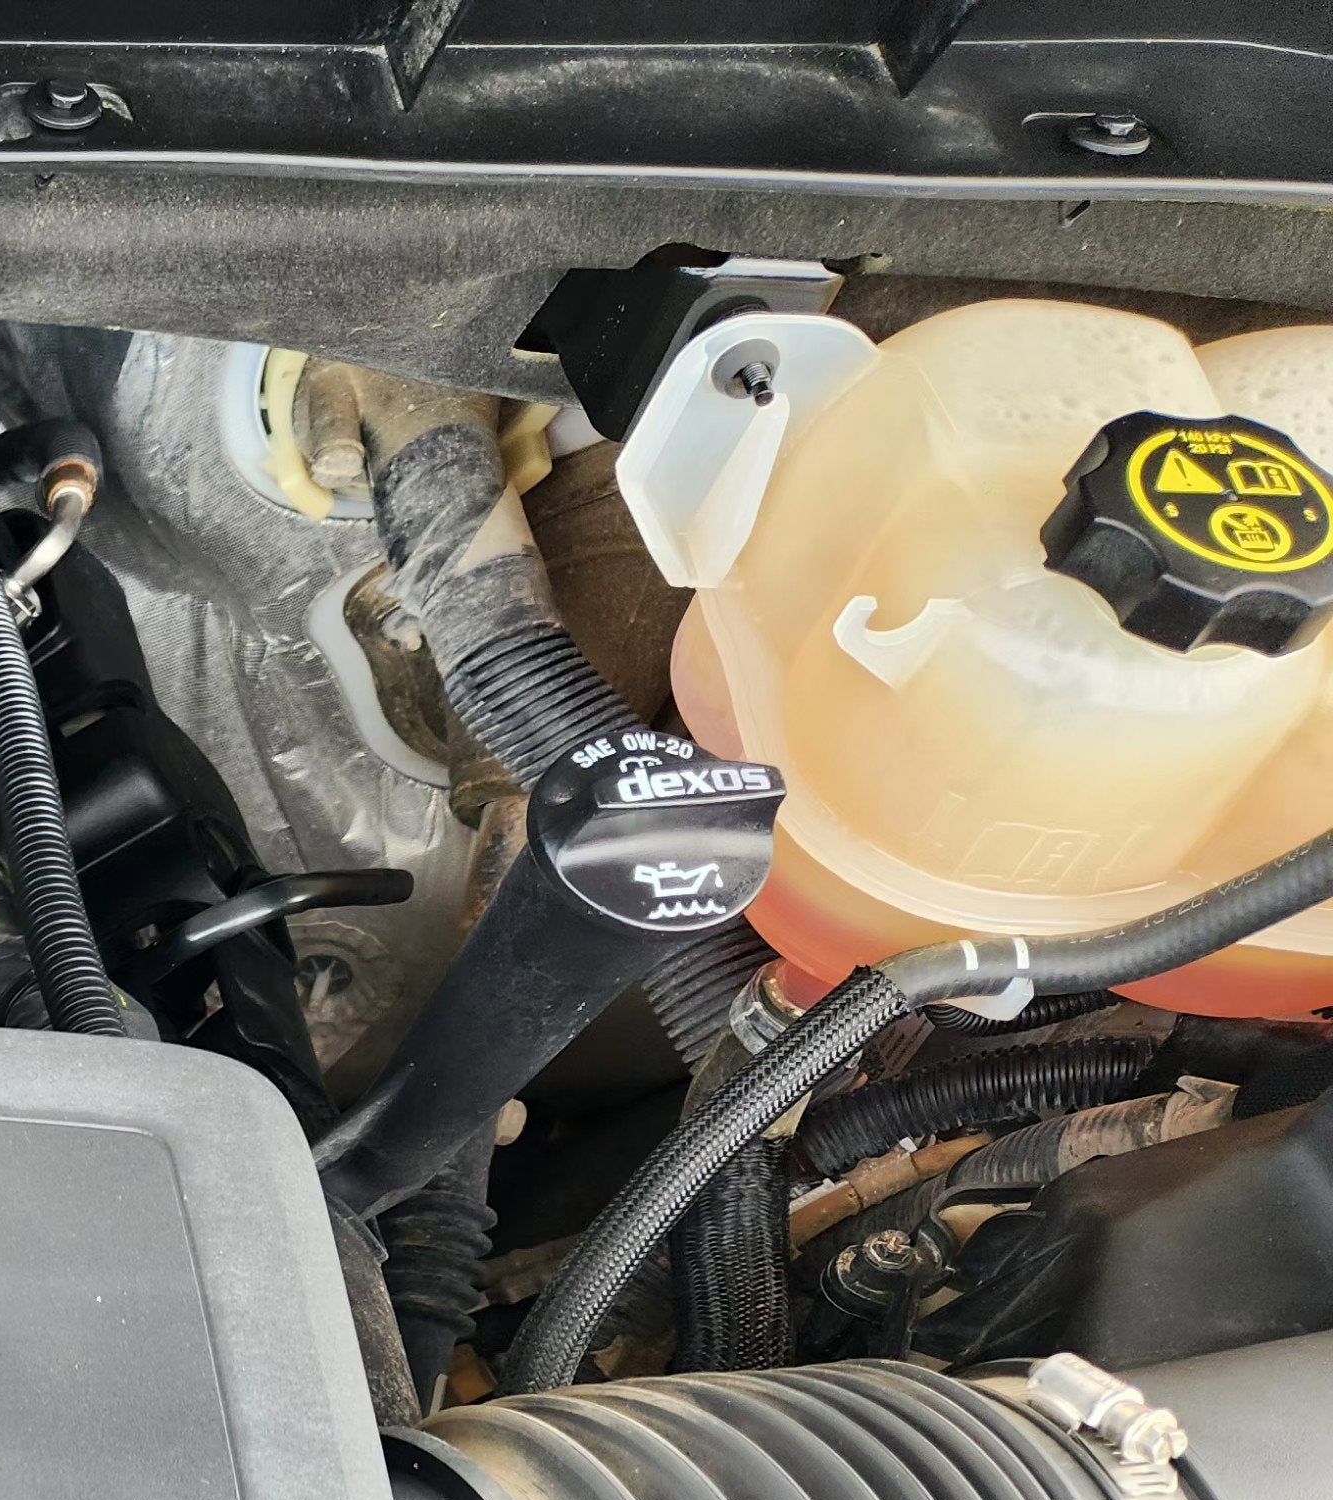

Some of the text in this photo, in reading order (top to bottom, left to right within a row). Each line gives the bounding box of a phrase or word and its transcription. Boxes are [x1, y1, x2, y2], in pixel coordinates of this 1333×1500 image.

[1178, 430, 1232, 443] 140 kPa
[1187, 443, 1232, 455] 20 PSI
[571, 732, 694, 769] SAE 0W-20
[616, 767, 771, 803] dexos
